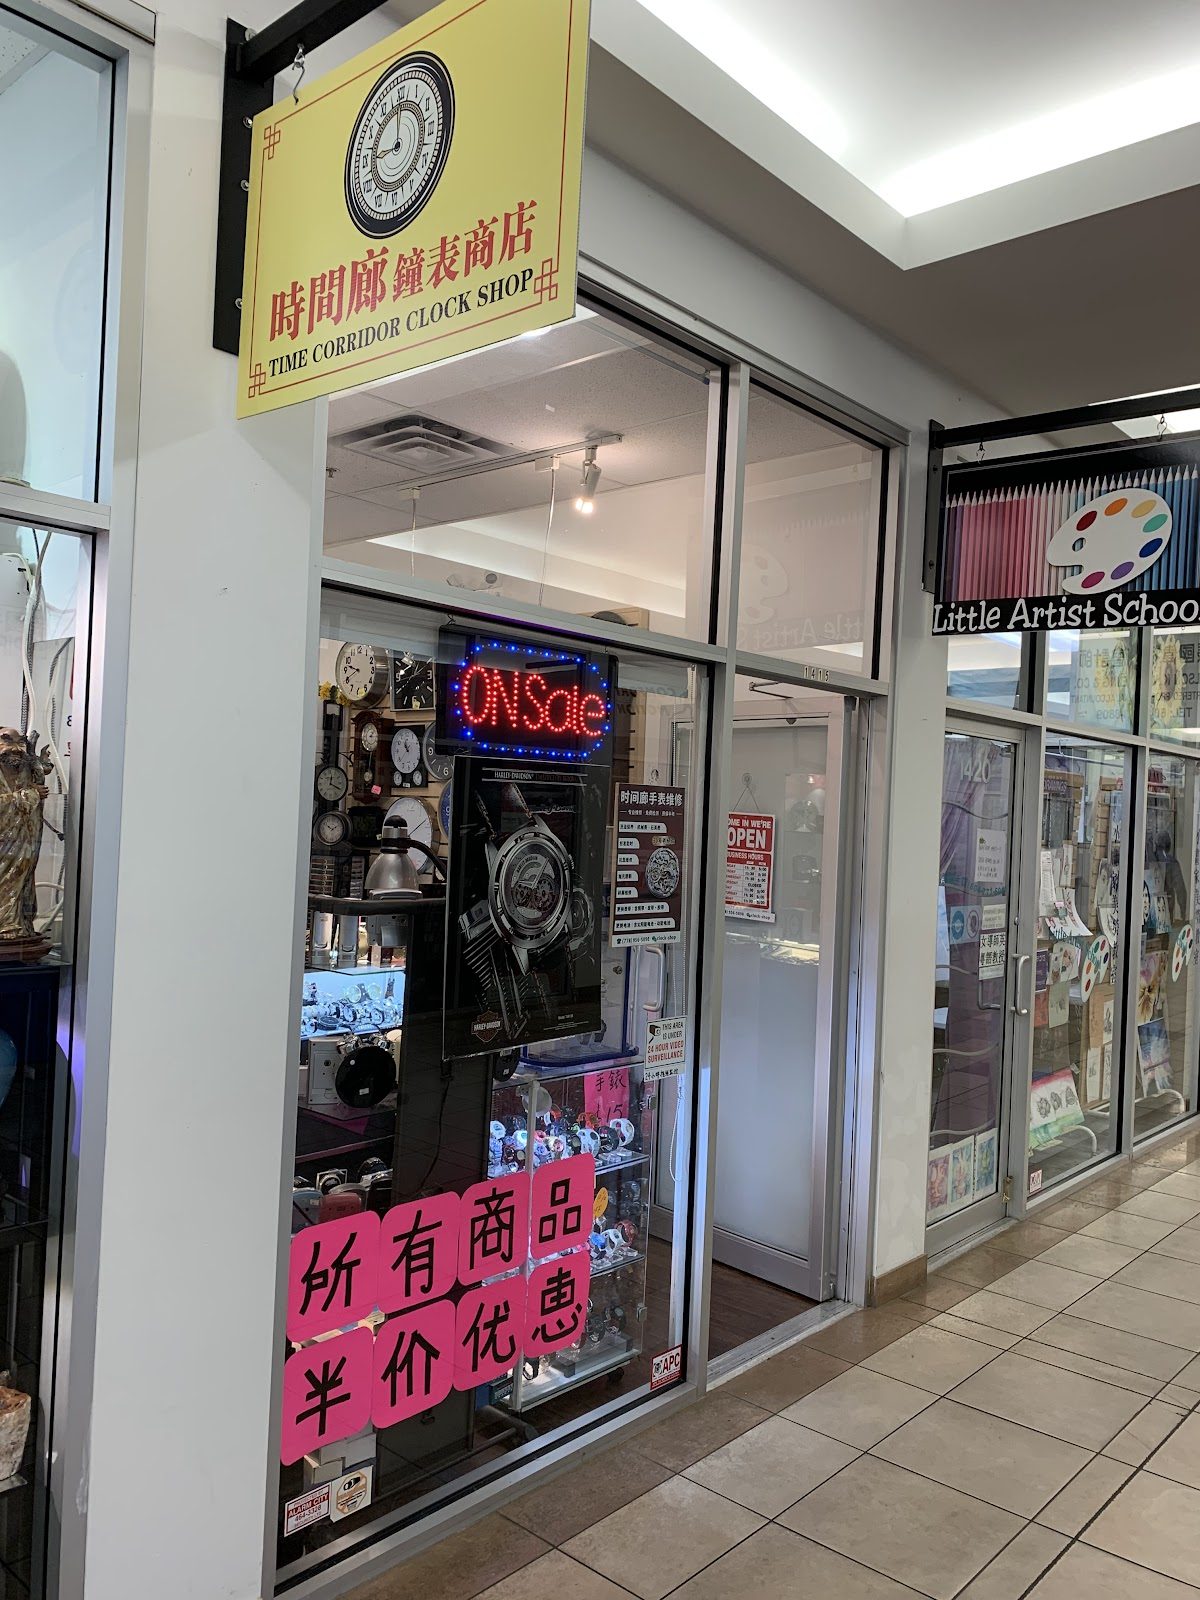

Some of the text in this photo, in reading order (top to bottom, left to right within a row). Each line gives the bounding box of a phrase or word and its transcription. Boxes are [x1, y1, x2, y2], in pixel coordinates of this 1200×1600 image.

[268, 199, 538, 342] 時間廊鐘表商店
[269, 267, 534, 378] TIME CORRIDOR CLOCK SHOP
[933, 592, 1200, 633] Little Artist Schoo
[804, 666, 829, 682] 1415
[428, 746, 434, 755] 9
[443, 767, 449, 776] 6
[961, 758, 990, 783] 1420
[620, 790, 683, 806] 时间廊手表维修
[742, 819, 749, 827] IN
[751, 820, 771, 828] WE'RE
[728, 827, 766, 849] OPEN
[748, 853, 764, 861] HOURS
[668, 1031, 682, 1039] UNDER
[655, 1043, 669, 1051] HOUR
[670, 1040, 684, 1050] VIDEO
[647, 1050, 683, 1063] SURVEILLANCE
[299, 1178, 581, 1317] 所有商品
[296, 1267, 583, 1437] 半价优惠
[662, 1352, 680, 1374] APC
[288, 1494, 328, 1517] ALARM CITY
